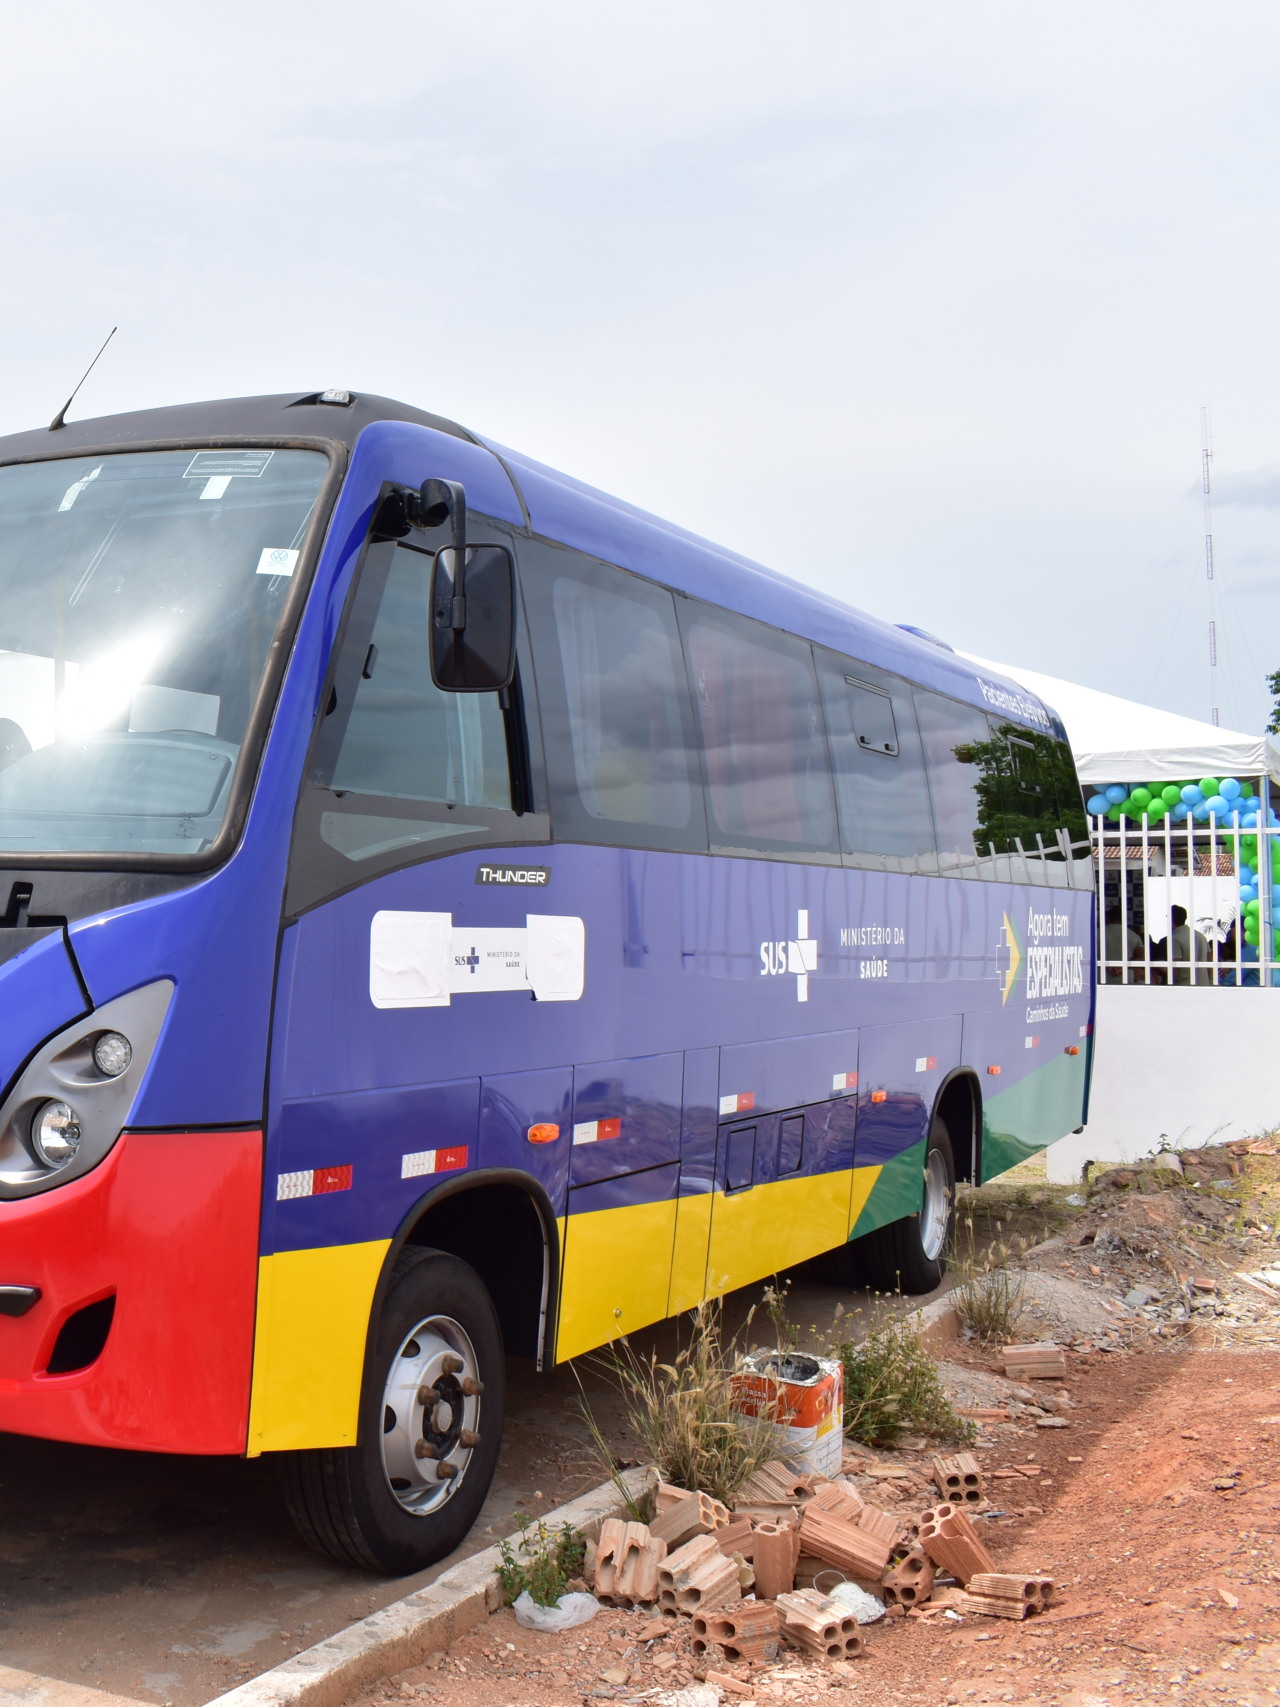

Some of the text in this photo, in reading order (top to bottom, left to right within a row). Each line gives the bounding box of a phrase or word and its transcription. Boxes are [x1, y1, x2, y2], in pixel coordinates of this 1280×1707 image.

[480, 867, 547, 884] THUNDER
[840, 922, 905, 946] MINISTÉRIO DA
[1027, 906, 1069, 945] Agora tem
[454, 955, 466, 966] SUS
[760, 941, 787, 976] SUS
[860, 956, 888, 979] SAÚDE
[1026, 946, 1083, 999] ESPECIALISTAS
[1025, 1004, 1049, 1024] Caminhos
[1049, 1003, 1055, 1019] da
